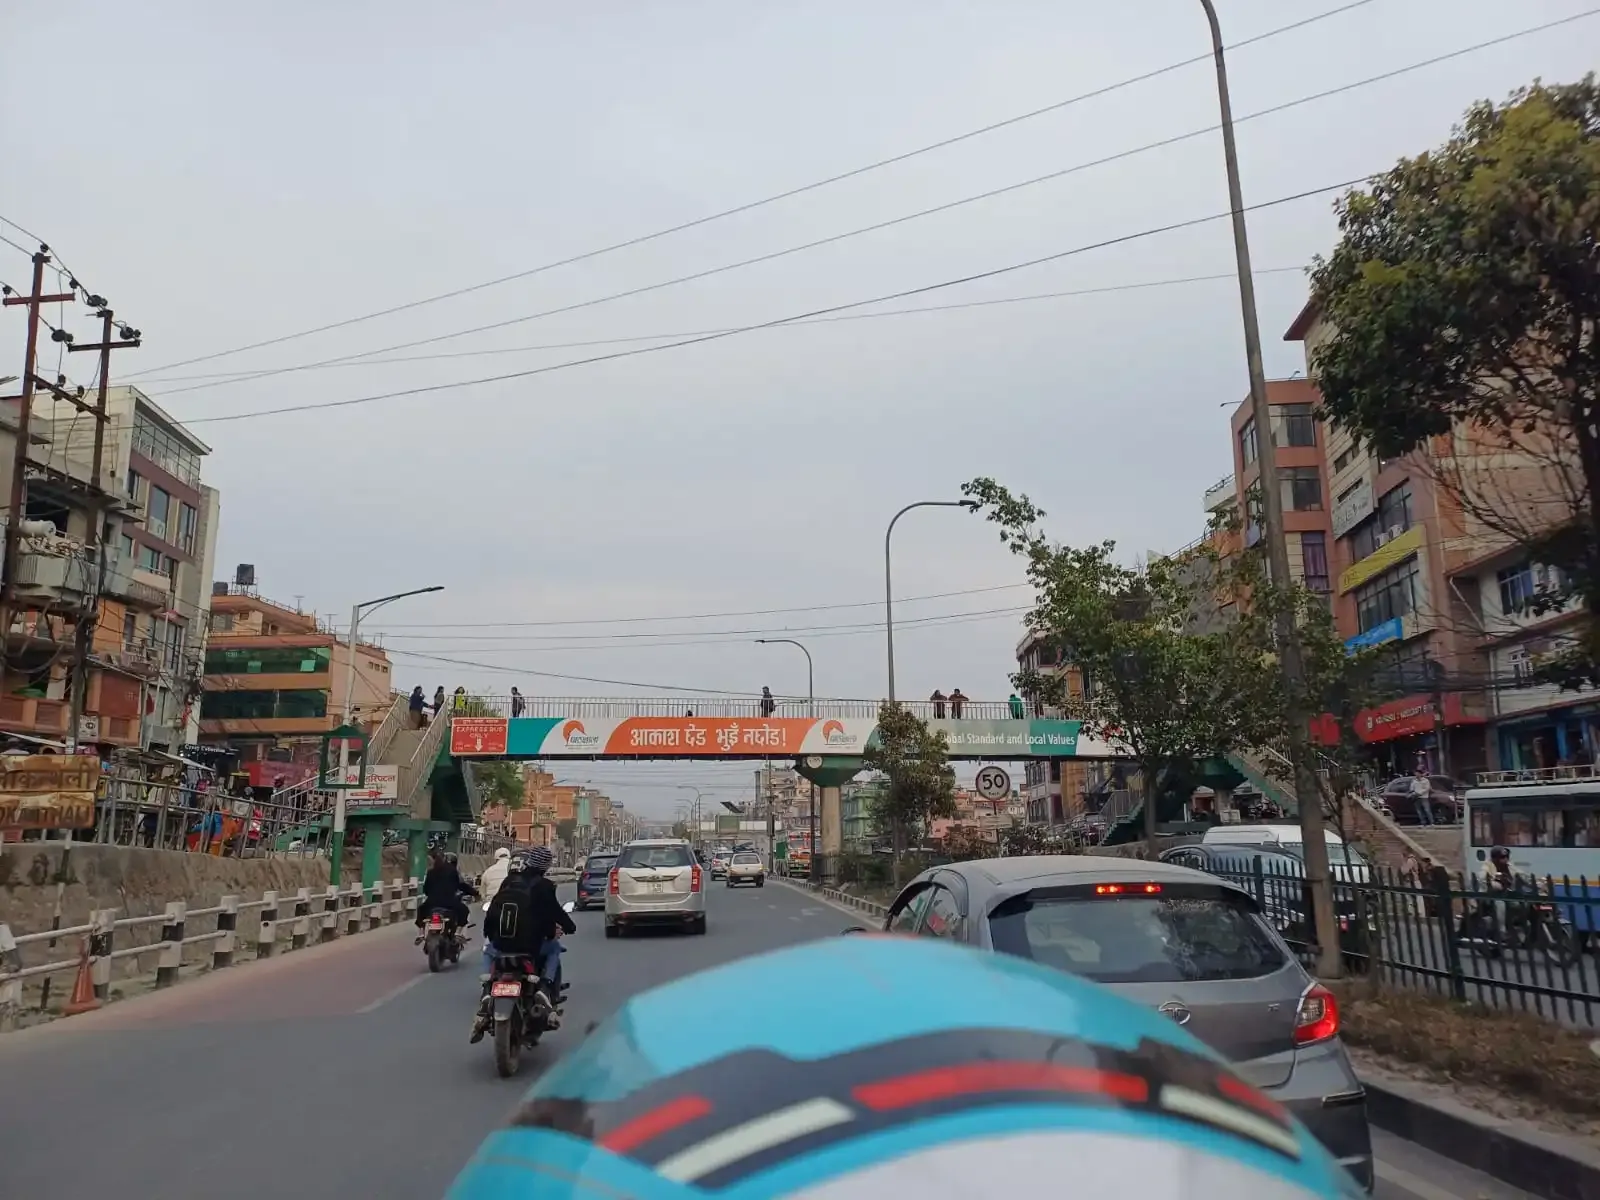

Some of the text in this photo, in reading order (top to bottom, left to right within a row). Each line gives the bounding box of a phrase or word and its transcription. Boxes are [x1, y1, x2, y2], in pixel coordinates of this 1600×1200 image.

[630, 728, 680, 746] आकाश
[967, 732, 1004, 745] Standard
[1006, 733, 1023, 745] and
[1025, 734, 1046, 745] Local
[1048, 734, 1075, 746] Values
[982, 773, 1004, 790] 50
